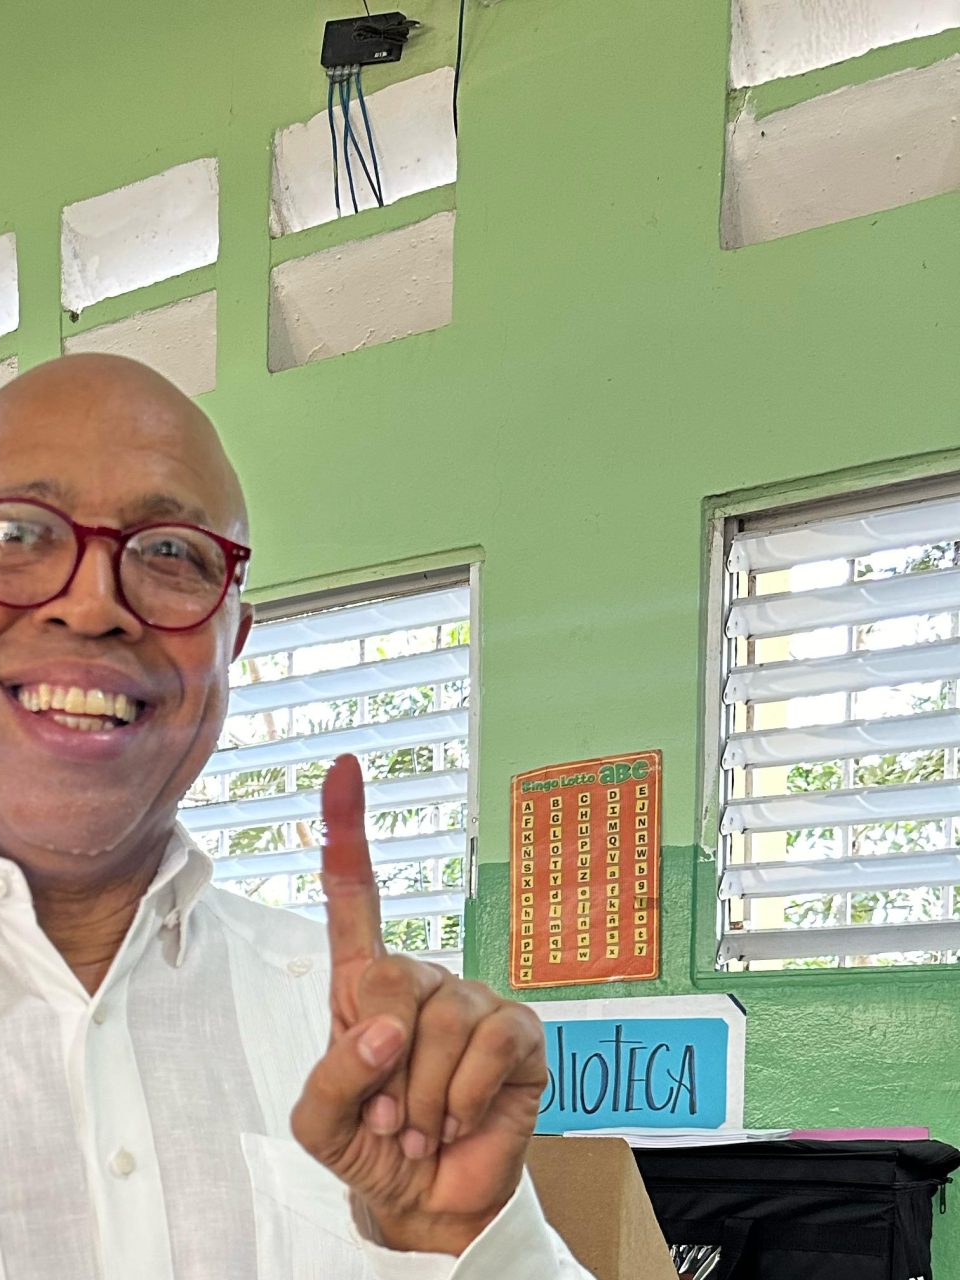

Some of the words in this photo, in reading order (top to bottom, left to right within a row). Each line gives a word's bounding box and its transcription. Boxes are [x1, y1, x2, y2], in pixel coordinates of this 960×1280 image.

[560, 774, 596, 788] Lotto
[524, 802, 532, 812] A
[552, 799, 560, 808] B
[609, 790, 617, 800] D
[639, 786, 646, 796] E
[524, 818, 531, 827] F
[551, 814, 560, 823] G
[580, 810, 588, 820] H
[639, 802, 645, 811] J
[523, 833, 532, 842] K
[552, 830, 559, 838] L
[608, 822, 618, 831] M
[638, 818, 646, 827] N
[580, 840, 588, 850] P
[609, 836, 617, 846] Q
[638, 834, 646, 843] R
[552, 860, 559, 869] T
[552, 875, 559, 885] Y
[609, 870, 616, 878] a
[638, 865, 645, 874] b
[551, 891, 559, 900] d
[610, 885, 616, 895] f
[638, 881, 645, 891] g
[524, 909, 530, 918] h
[609, 900, 616, 909] k
[609, 915, 616, 924] ñ
[523, 941, 530, 950] p
[551, 939, 559, 948] q
[638, 931, 643, 939] t
[638, 946, 644, 955] y
